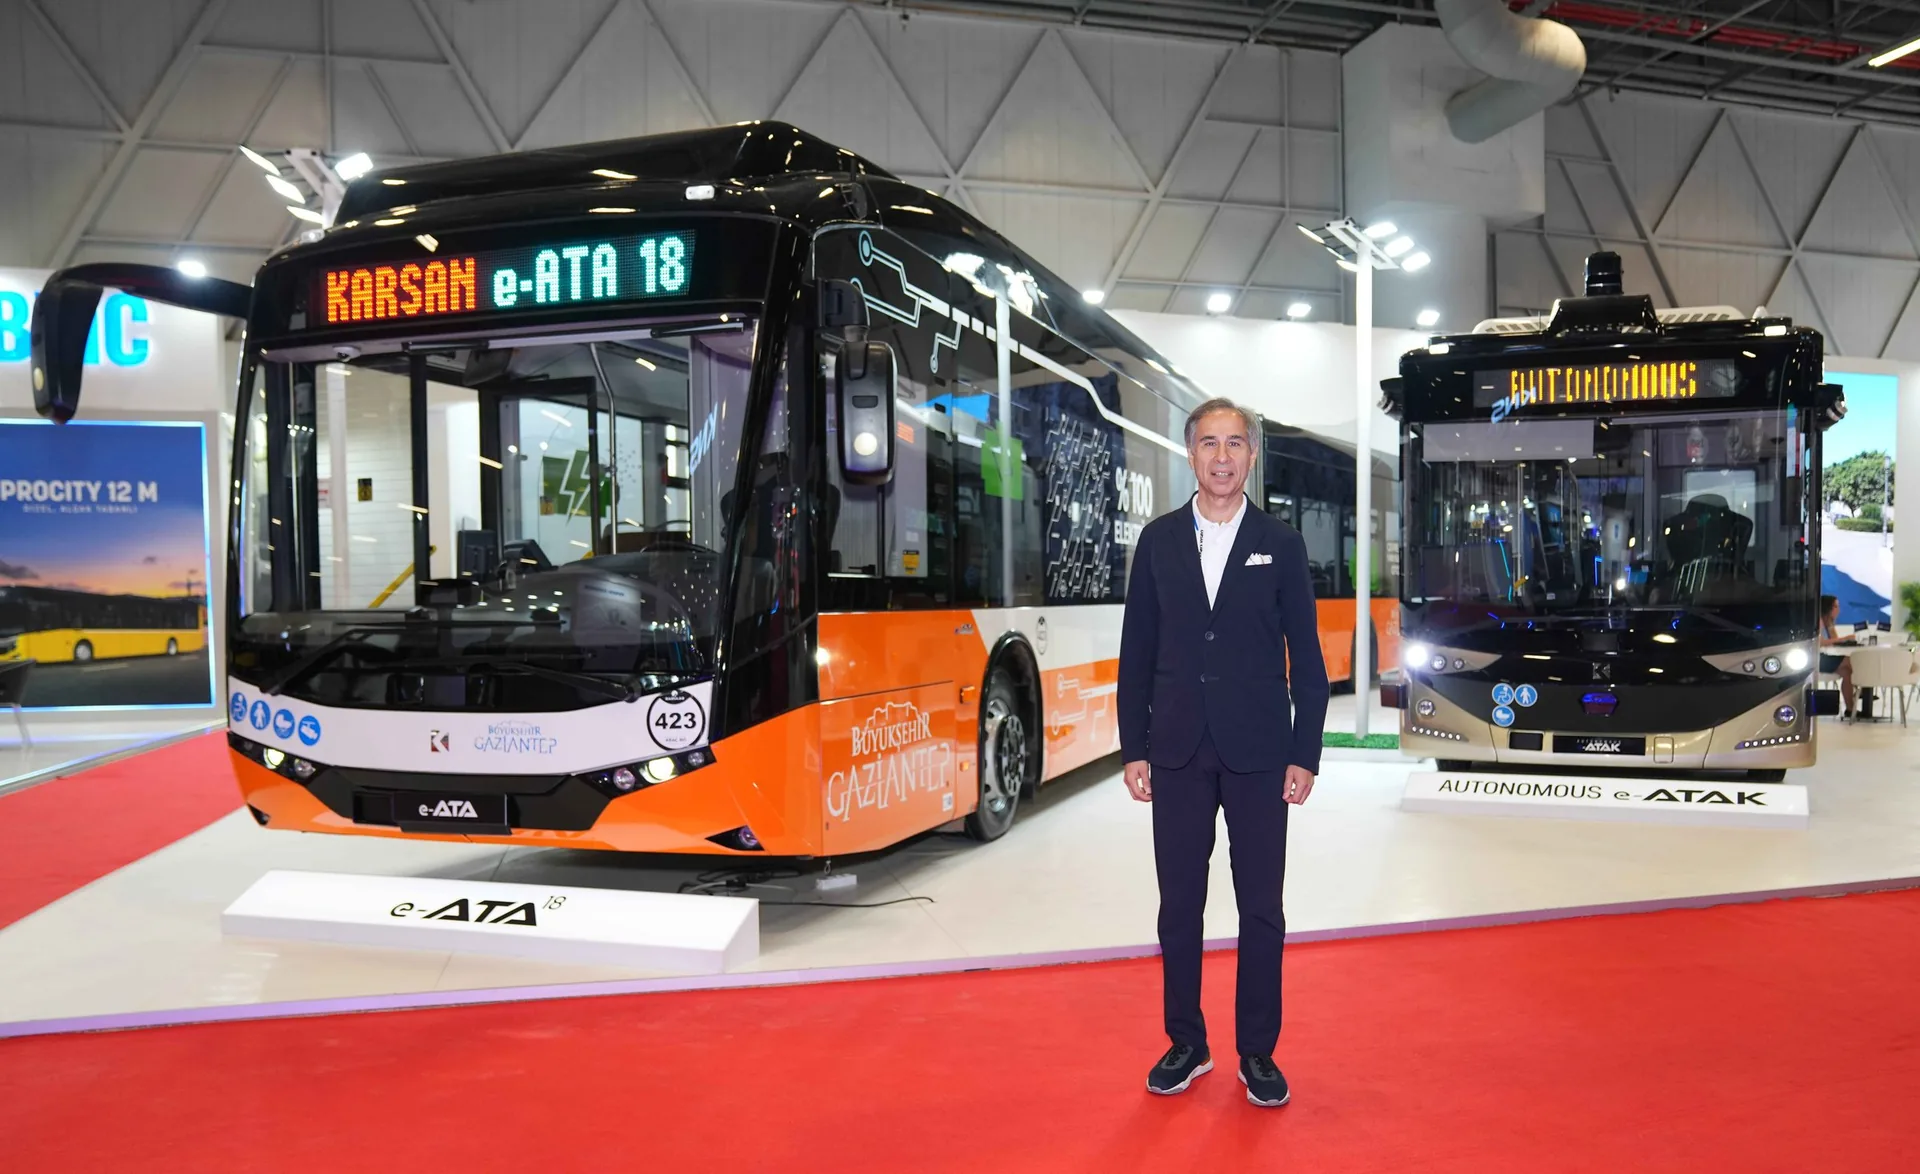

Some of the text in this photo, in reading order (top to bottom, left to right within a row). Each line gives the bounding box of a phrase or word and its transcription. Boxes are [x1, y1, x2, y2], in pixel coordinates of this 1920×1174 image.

[327, 235, 685, 323] KARSAN e-ATA 18
[0, 290, 149, 367] BC
[0, 479, 158, 502] PROCITY 12 M
[655, 712, 697, 730] 423
[1438, 779, 1769, 806] AUTONOMOUS e-ATAK
[418, 799, 479, 818] e-ATA
[390, 895, 567, 927] e-ATA 18
